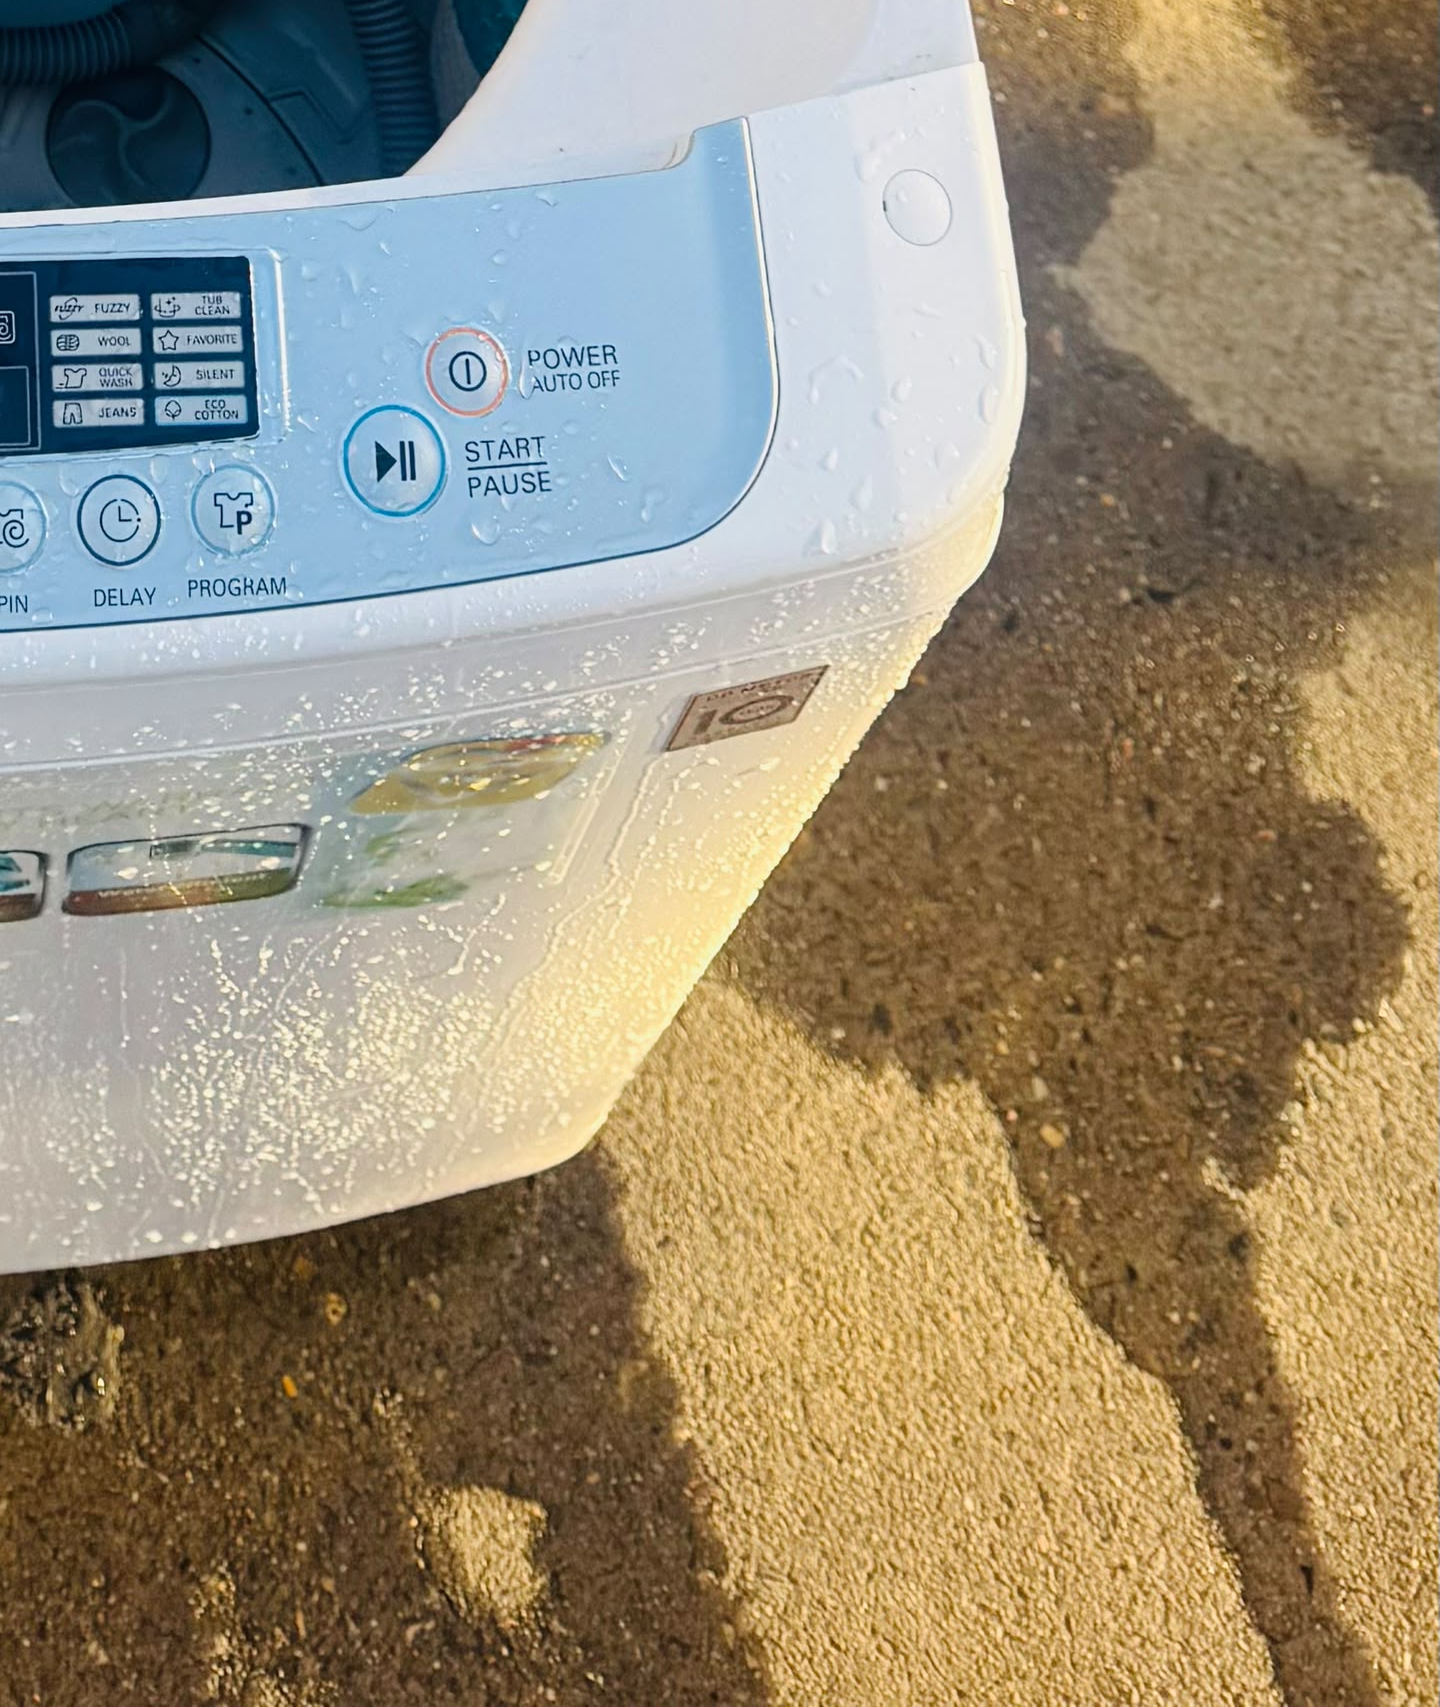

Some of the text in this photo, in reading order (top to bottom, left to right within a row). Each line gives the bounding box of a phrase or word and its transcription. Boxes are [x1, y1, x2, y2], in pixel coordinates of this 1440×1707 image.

[201, 295, 224, 305] TUB
[94, 301, 131, 315] FUZZY
[194, 304, 231, 316] CLEAN
[97, 335, 132, 347] WOOL
[186, 333, 238, 346] FAVORITE
[527, 344, 618, 370] POWER
[98, 367, 134, 378] QUICK
[195, 368, 236, 380] SILENT
[98, 377, 134, 388] WASH
[532, 369, 621, 393] AUTO OFF
[204, 398, 227, 410] ECO
[98, 406, 137, 418] JEANS
[194, 409, 240, 421] COTTON
[464, 436, 547, 463] START
[467, 470, 553, 498] PAUSE
[188, 576, 287, 599] PROGRAM
[93, 587, 157, 607] DELAY
